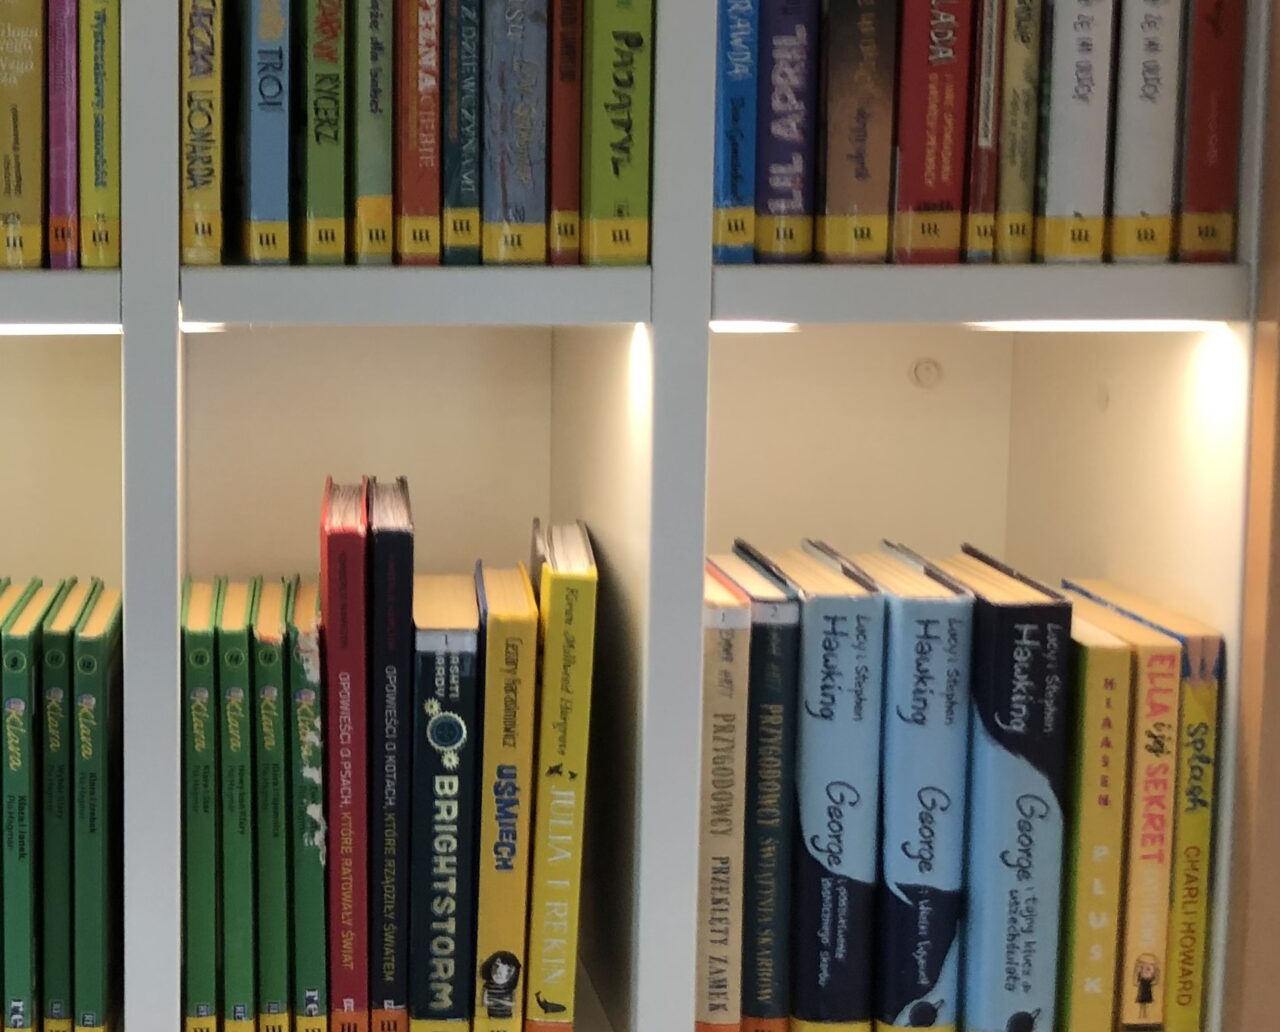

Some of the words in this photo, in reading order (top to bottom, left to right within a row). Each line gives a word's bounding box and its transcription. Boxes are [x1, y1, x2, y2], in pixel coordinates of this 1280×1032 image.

[313, 73, 340, 145] RYCERZ
[501, 638, 524, 675] Cezary
[805, 616, 847, 721] Hawking
[851, 615, 869, 650] Lucy
[943, 618, 962, 656] Lucy
[1042, 623, 1063, 660] Lucy
[383, 665, 401, 740] OPOWIEŚCI
[851, 666, 870, 722] Stephen
[896, 619, 940, 726] Hawking
[944, 670, 963, 726] Stephen
[994, 624, 1041, 734] Hawking
[1041, 675, 1062, 733] Stephen
[1144, 655, 1175, 720] ELLA
[6, 709, 26, 772] Klara
[76, 705, 97, 760] Klara
[226, 700, 245, 753] Klara
[260, 698, 279, 751] Klara
[709, 713, 735, 837] PRZYGODOWCY
[756, 704, 784, 826] PRZYGODOWCY
[491, 764, 521, 870] UŚMIECH
[545, 786, 575, 863] JULIA
[810, 781, 859, 869] George
[901, 786, 951, 874] George
[1000, 794, 1050, 882] George
[1140, 763, 1169, 865] SEKRET
[428, 775, 459, 1010] BRIGHTSTORM
[707, 856, 731, 946] PRZEKLĘTY
[752, 836, 778, 923] ŚWIĄTYNIA
[1018, 896, 1038, 934] tajny
[1180, 846, 1201, 917] CHARLI
[340, 931, 358, 969] ŚWIAT
[539, 902, 568, 986] REKIN
[1083, 846, 1109, 995] PLUSK
[707, 956, 730, 1013] ZAMEK
[755, 928, 776, 1004] SKARBÓW
[1175, 922, 1197, 1007] HOWARD
